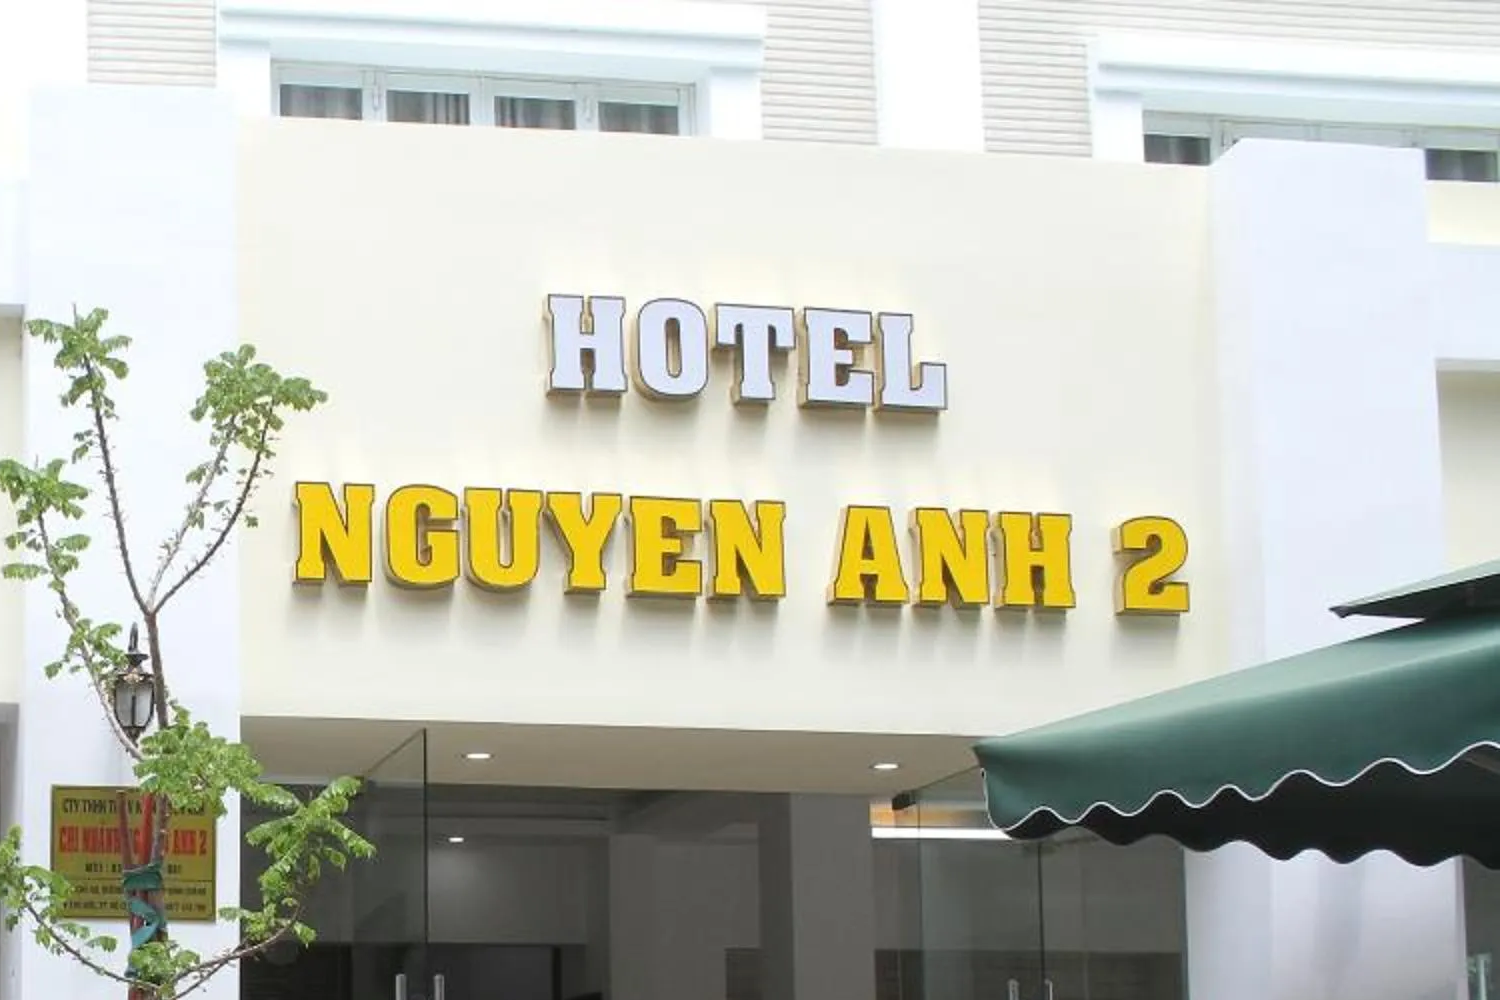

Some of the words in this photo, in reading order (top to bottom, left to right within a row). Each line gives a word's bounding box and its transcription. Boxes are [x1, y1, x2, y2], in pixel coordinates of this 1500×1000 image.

[543, 292, 948, 411] HOTEL
[292, 480, 786, 599] NGUYEN
[826, 503, 1077, 610] ANH
[1111, 514, 1191, 616] 2
